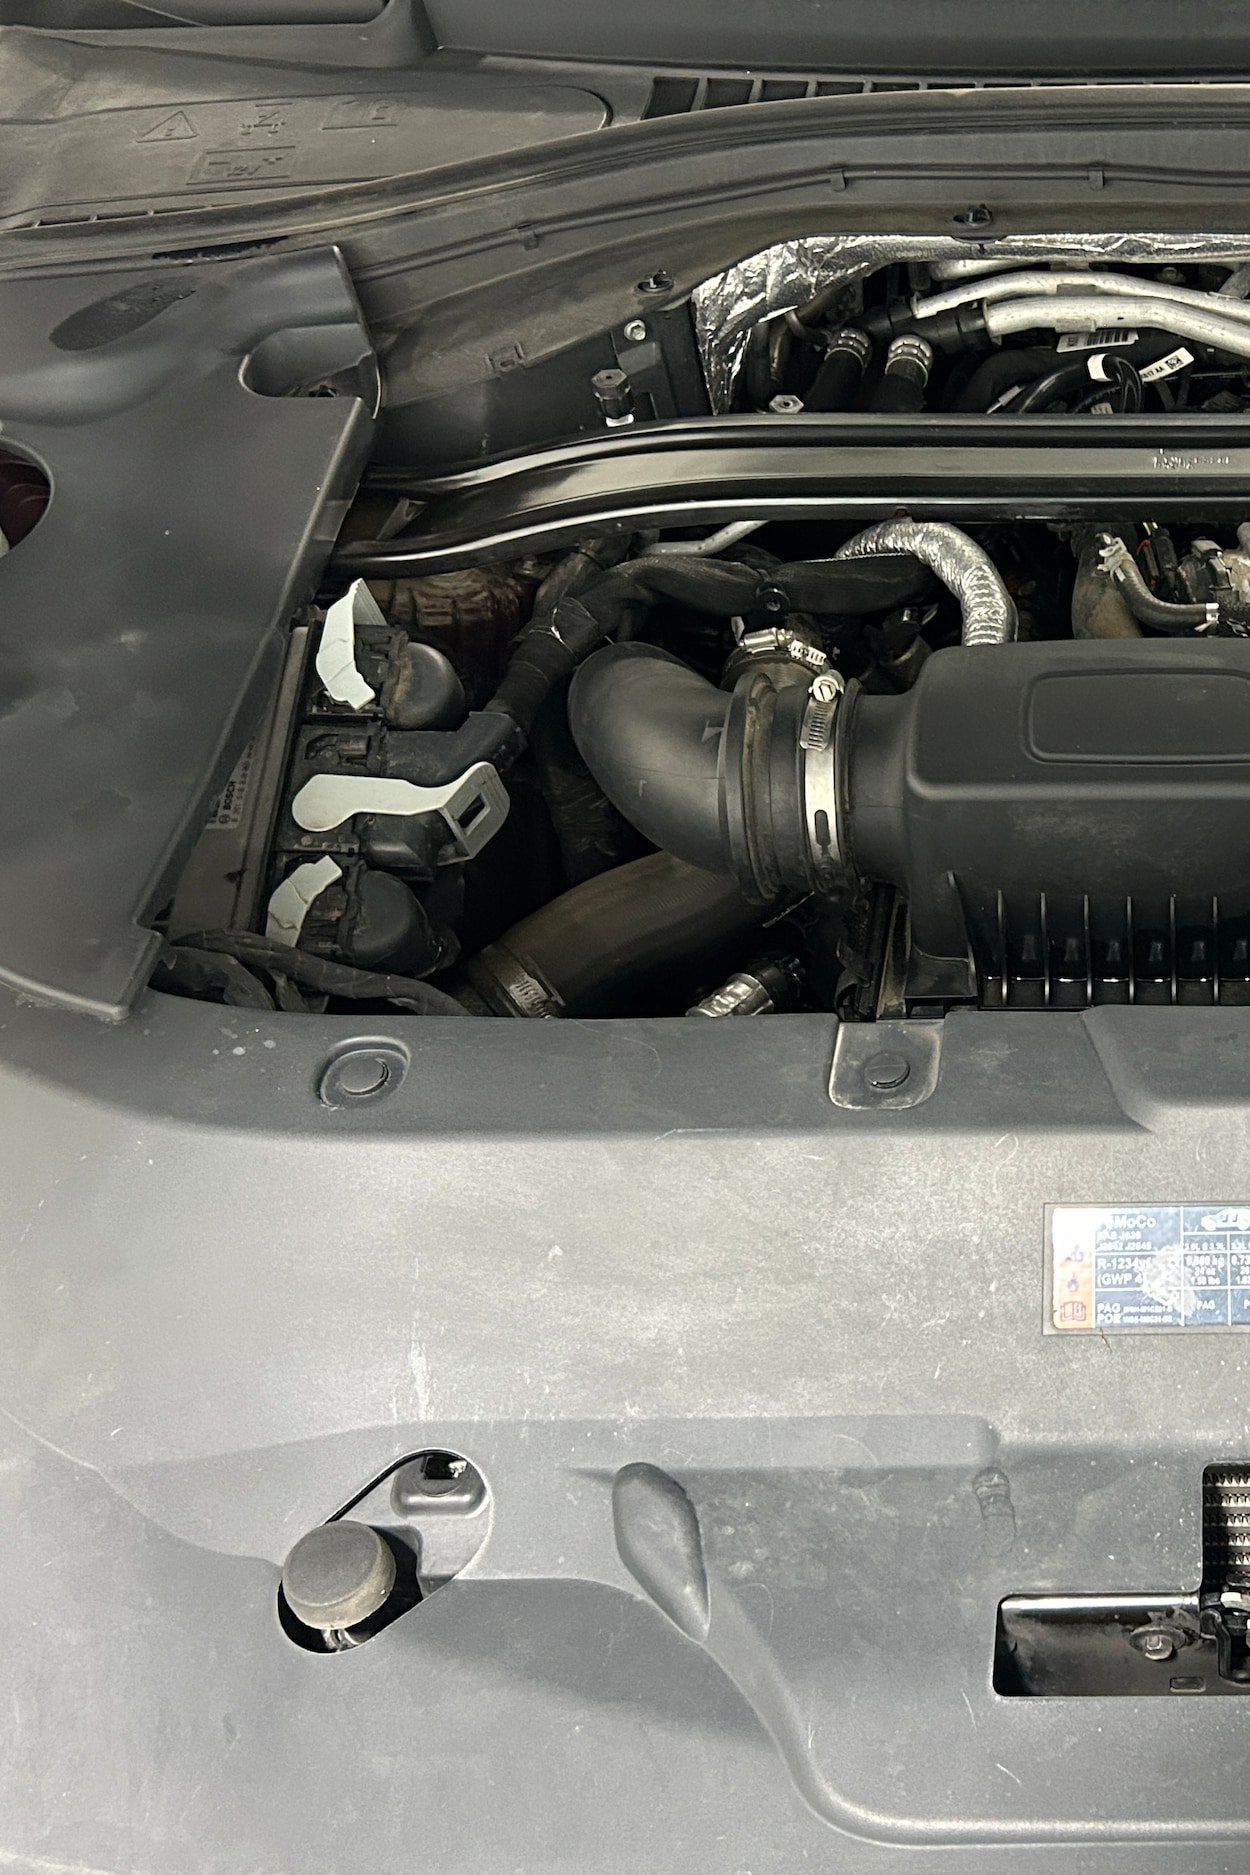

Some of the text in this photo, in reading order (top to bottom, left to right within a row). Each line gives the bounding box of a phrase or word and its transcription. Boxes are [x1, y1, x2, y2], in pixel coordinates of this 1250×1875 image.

[223, 780, 236, 810] BOSCH
[1097, 1303, 1120, 1314] PAG
[1197, 1300, 1216, 1310] PAG
